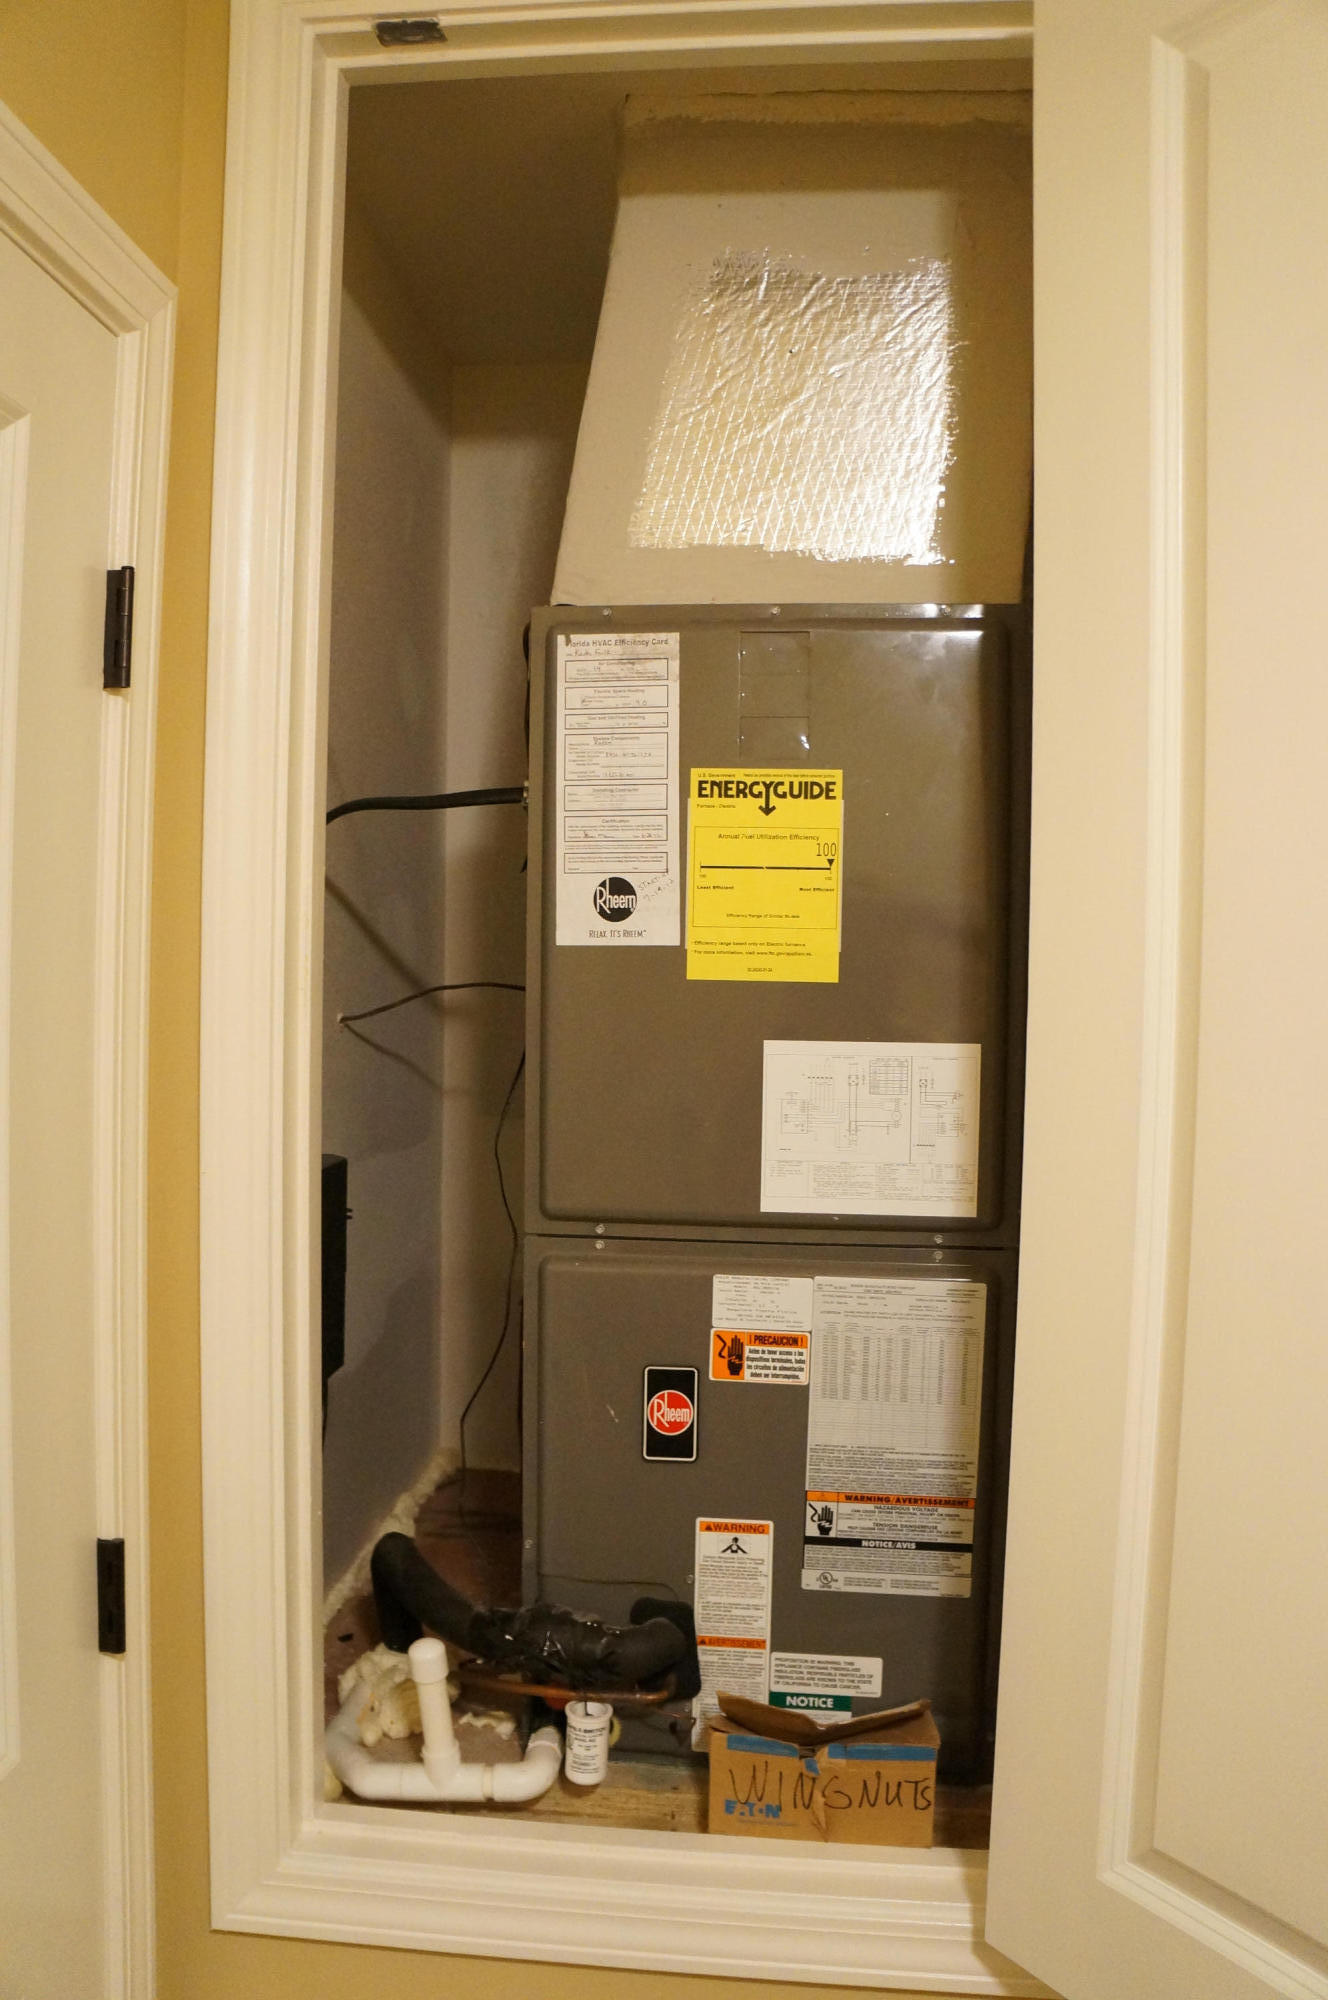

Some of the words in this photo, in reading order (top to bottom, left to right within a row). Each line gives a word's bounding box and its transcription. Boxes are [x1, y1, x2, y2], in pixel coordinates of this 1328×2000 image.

[592, 639, 612, 647] HVAC
[614, 638, 650, 648] Efficiency
[652, 638, 669, 646] Card
[698, 780, 837, 802] ENERGYGUIDE
[816, 842, 837, 857] 100
[596, 878, 636, 914] Rheem
[754, 1335, 799, 1346] PRECAUCION
[653, 1392, 690, 1428] Rheem
[712, 1523, 765, 1534] WARNING
[786, 1696, 834, 1708] NOTICE
